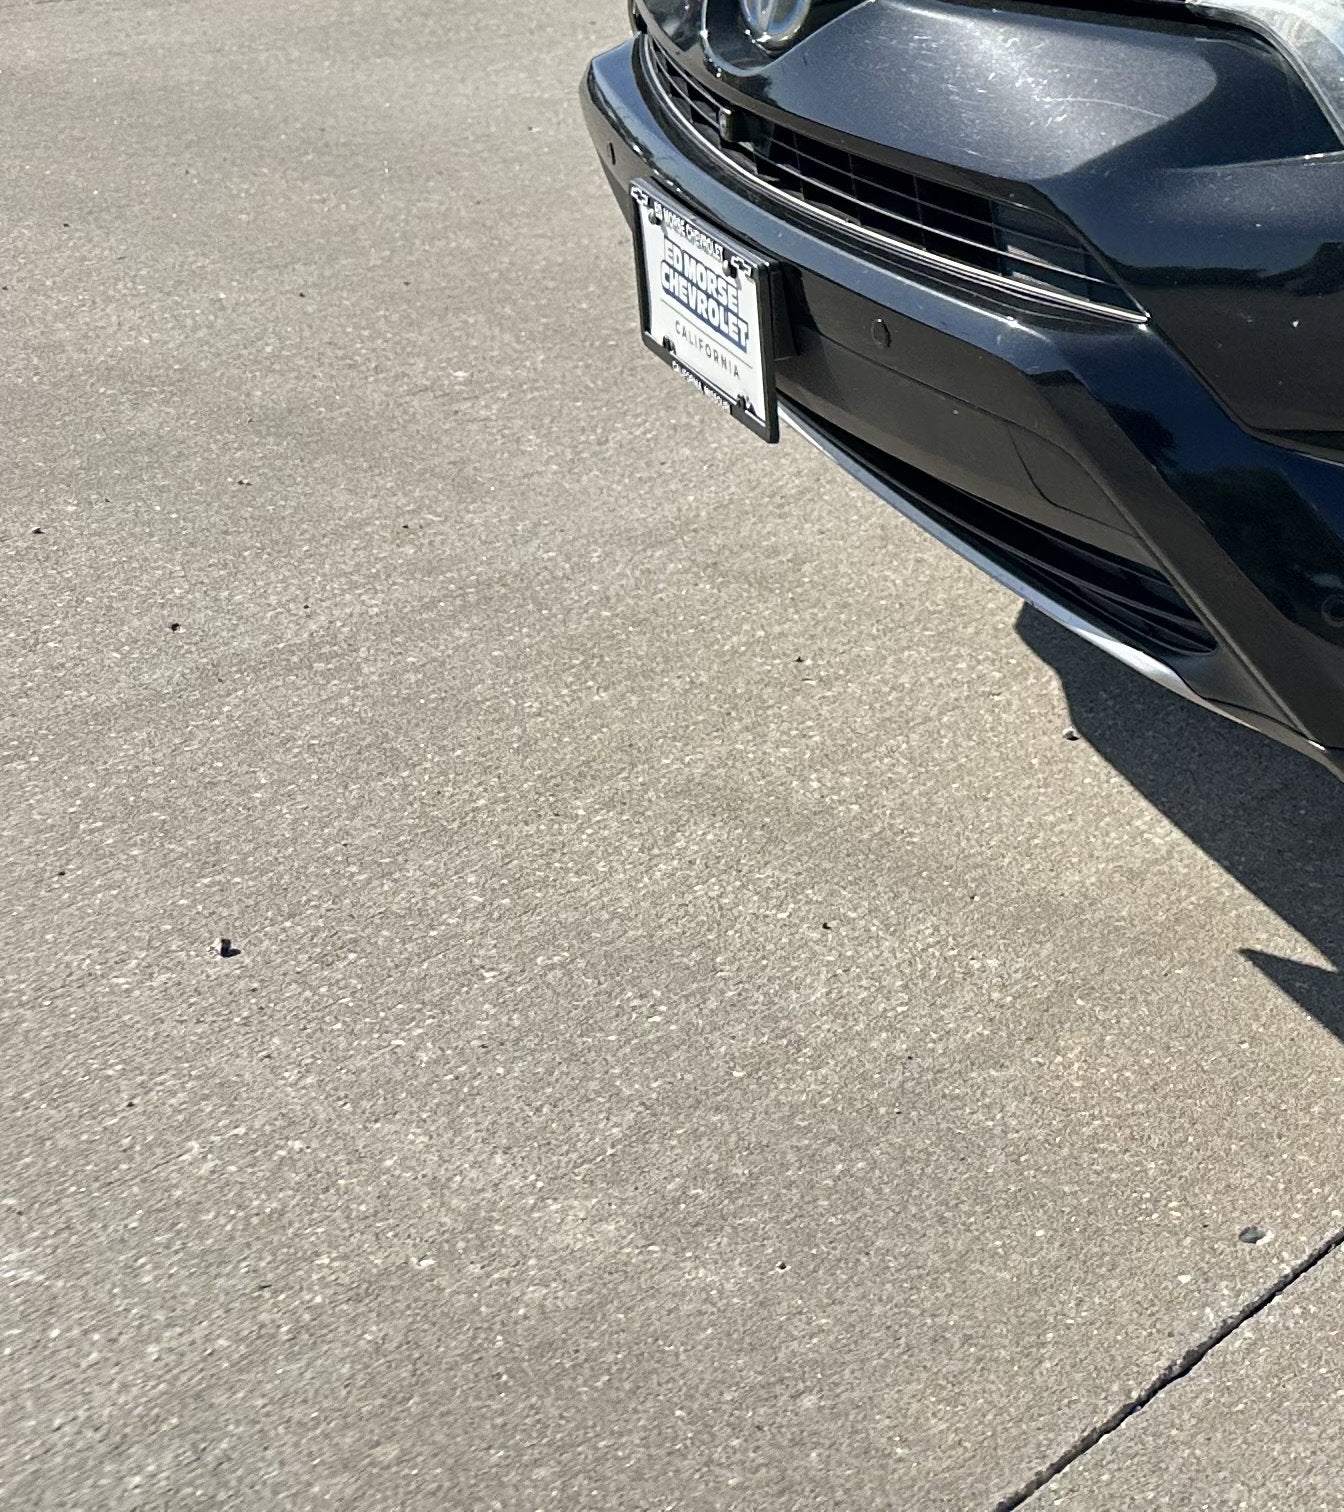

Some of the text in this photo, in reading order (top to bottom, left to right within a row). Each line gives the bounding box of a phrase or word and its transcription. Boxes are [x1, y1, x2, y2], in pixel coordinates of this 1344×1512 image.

[660, 259, 749, 354] CHEVROLET
[663, 236, 739, 314] ED MORSE
[674, 319, 741, 380] CALIFORNIA
